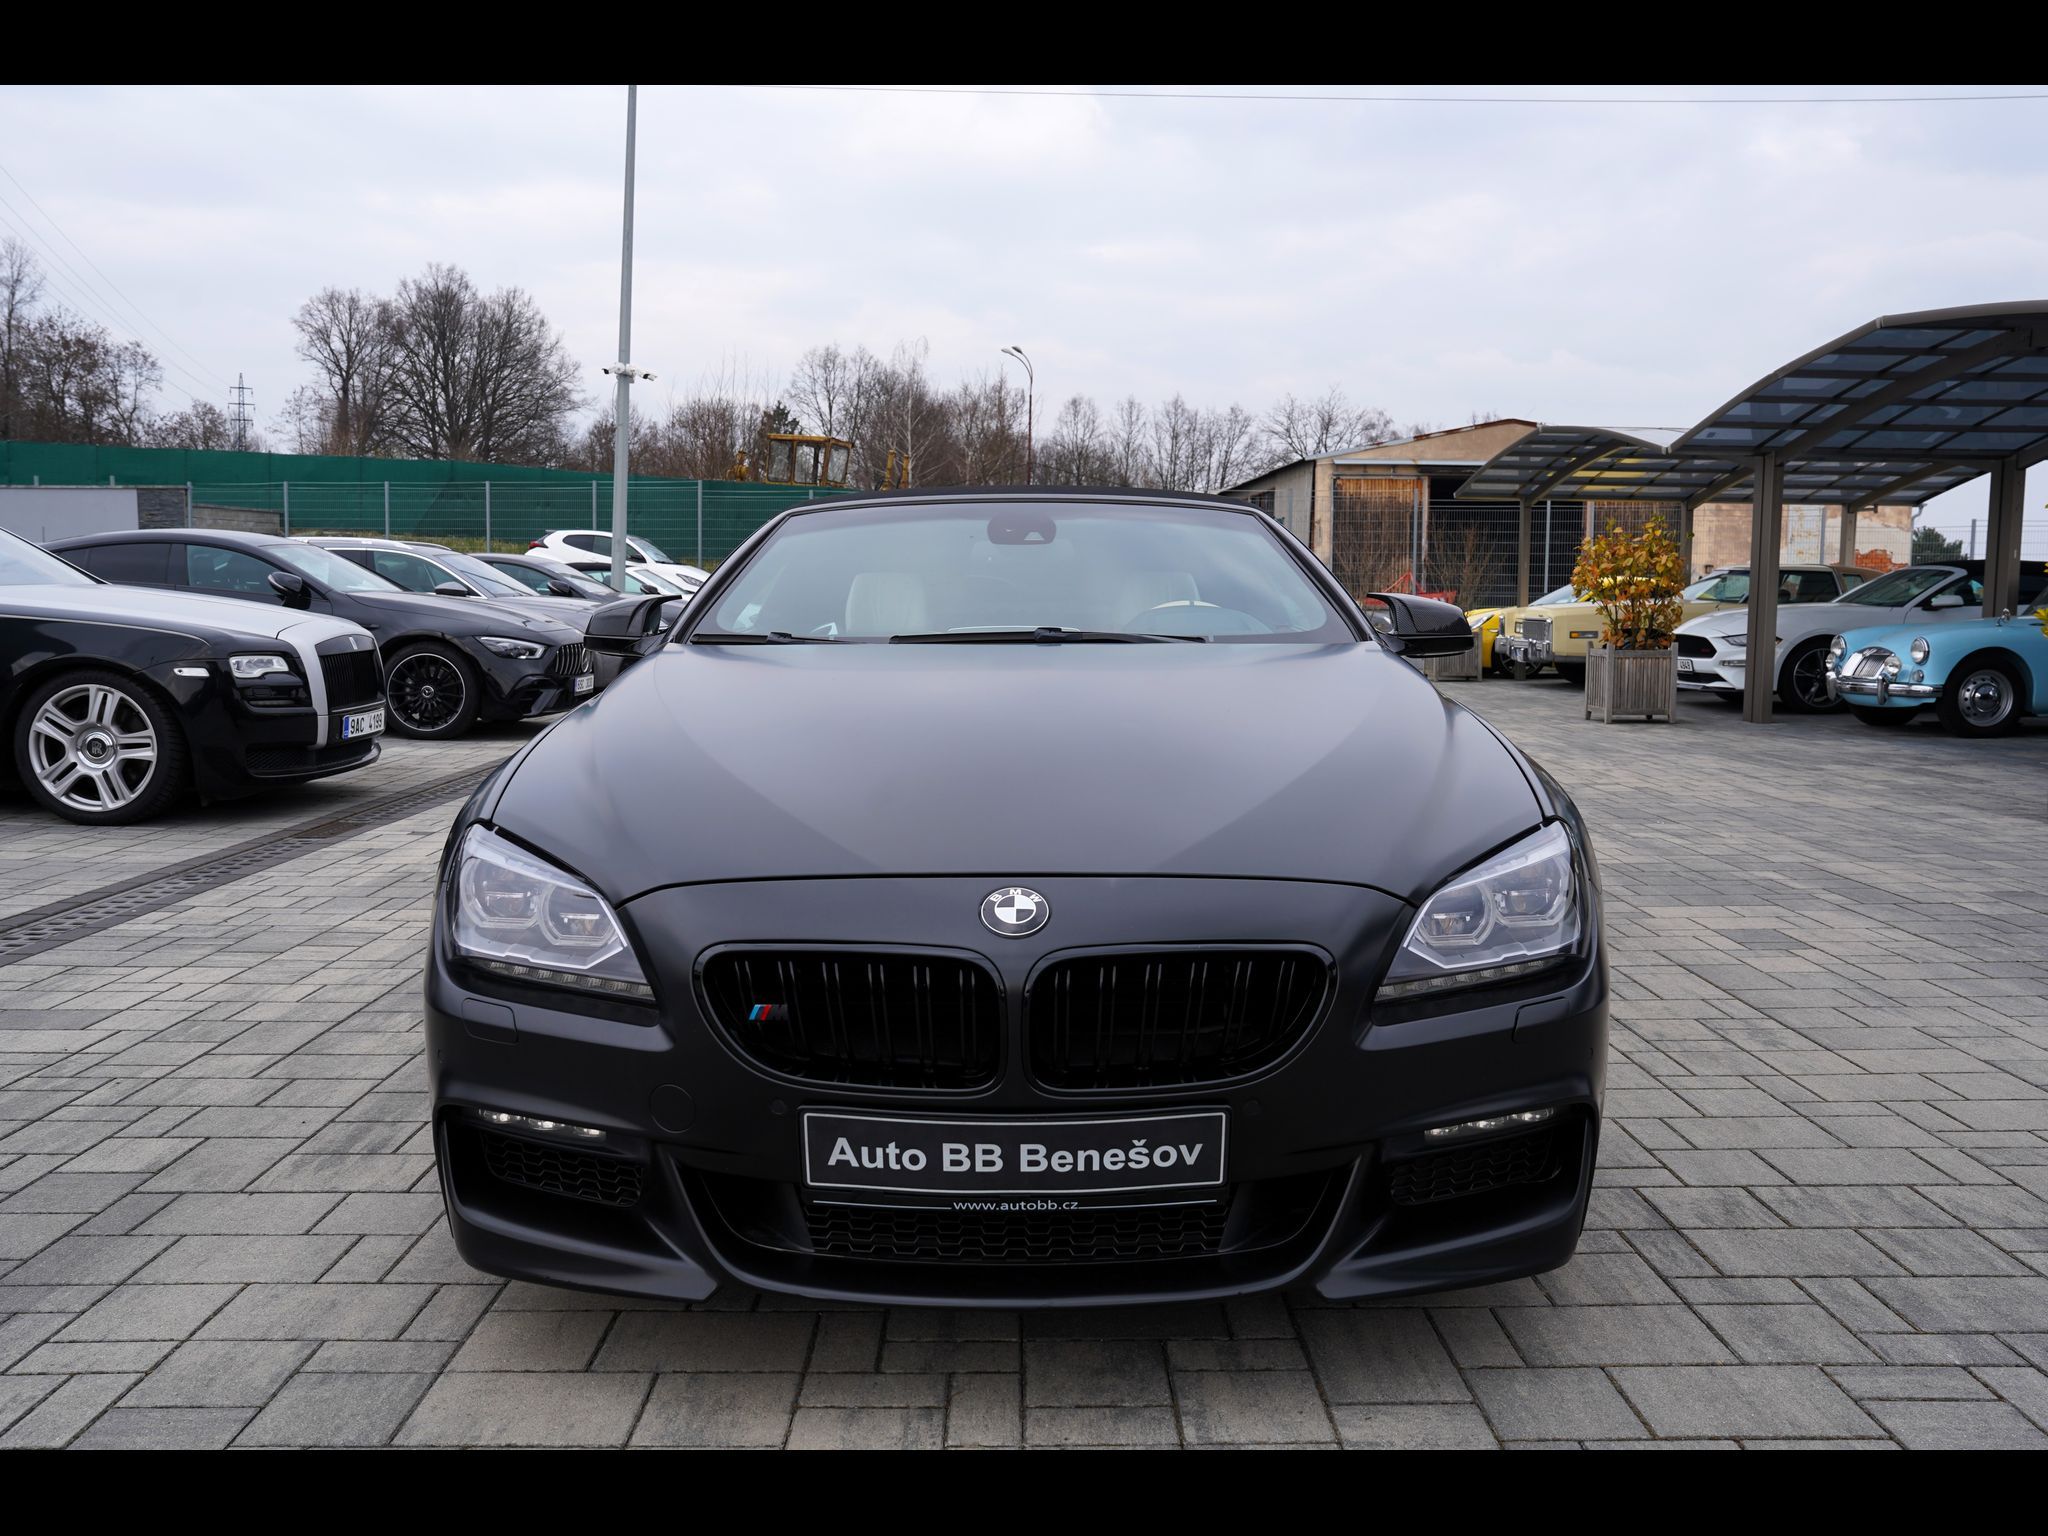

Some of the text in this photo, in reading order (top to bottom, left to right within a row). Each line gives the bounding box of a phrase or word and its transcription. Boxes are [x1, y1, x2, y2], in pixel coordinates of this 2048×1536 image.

[350, 712, 383, 735] 9AC 4199
[989, 888, 1042, 903] BMW
[827, 1137, 1203, 1173] Auto BB Benešov
[953, 1199, 1079, 1211] www.autobb.cz
